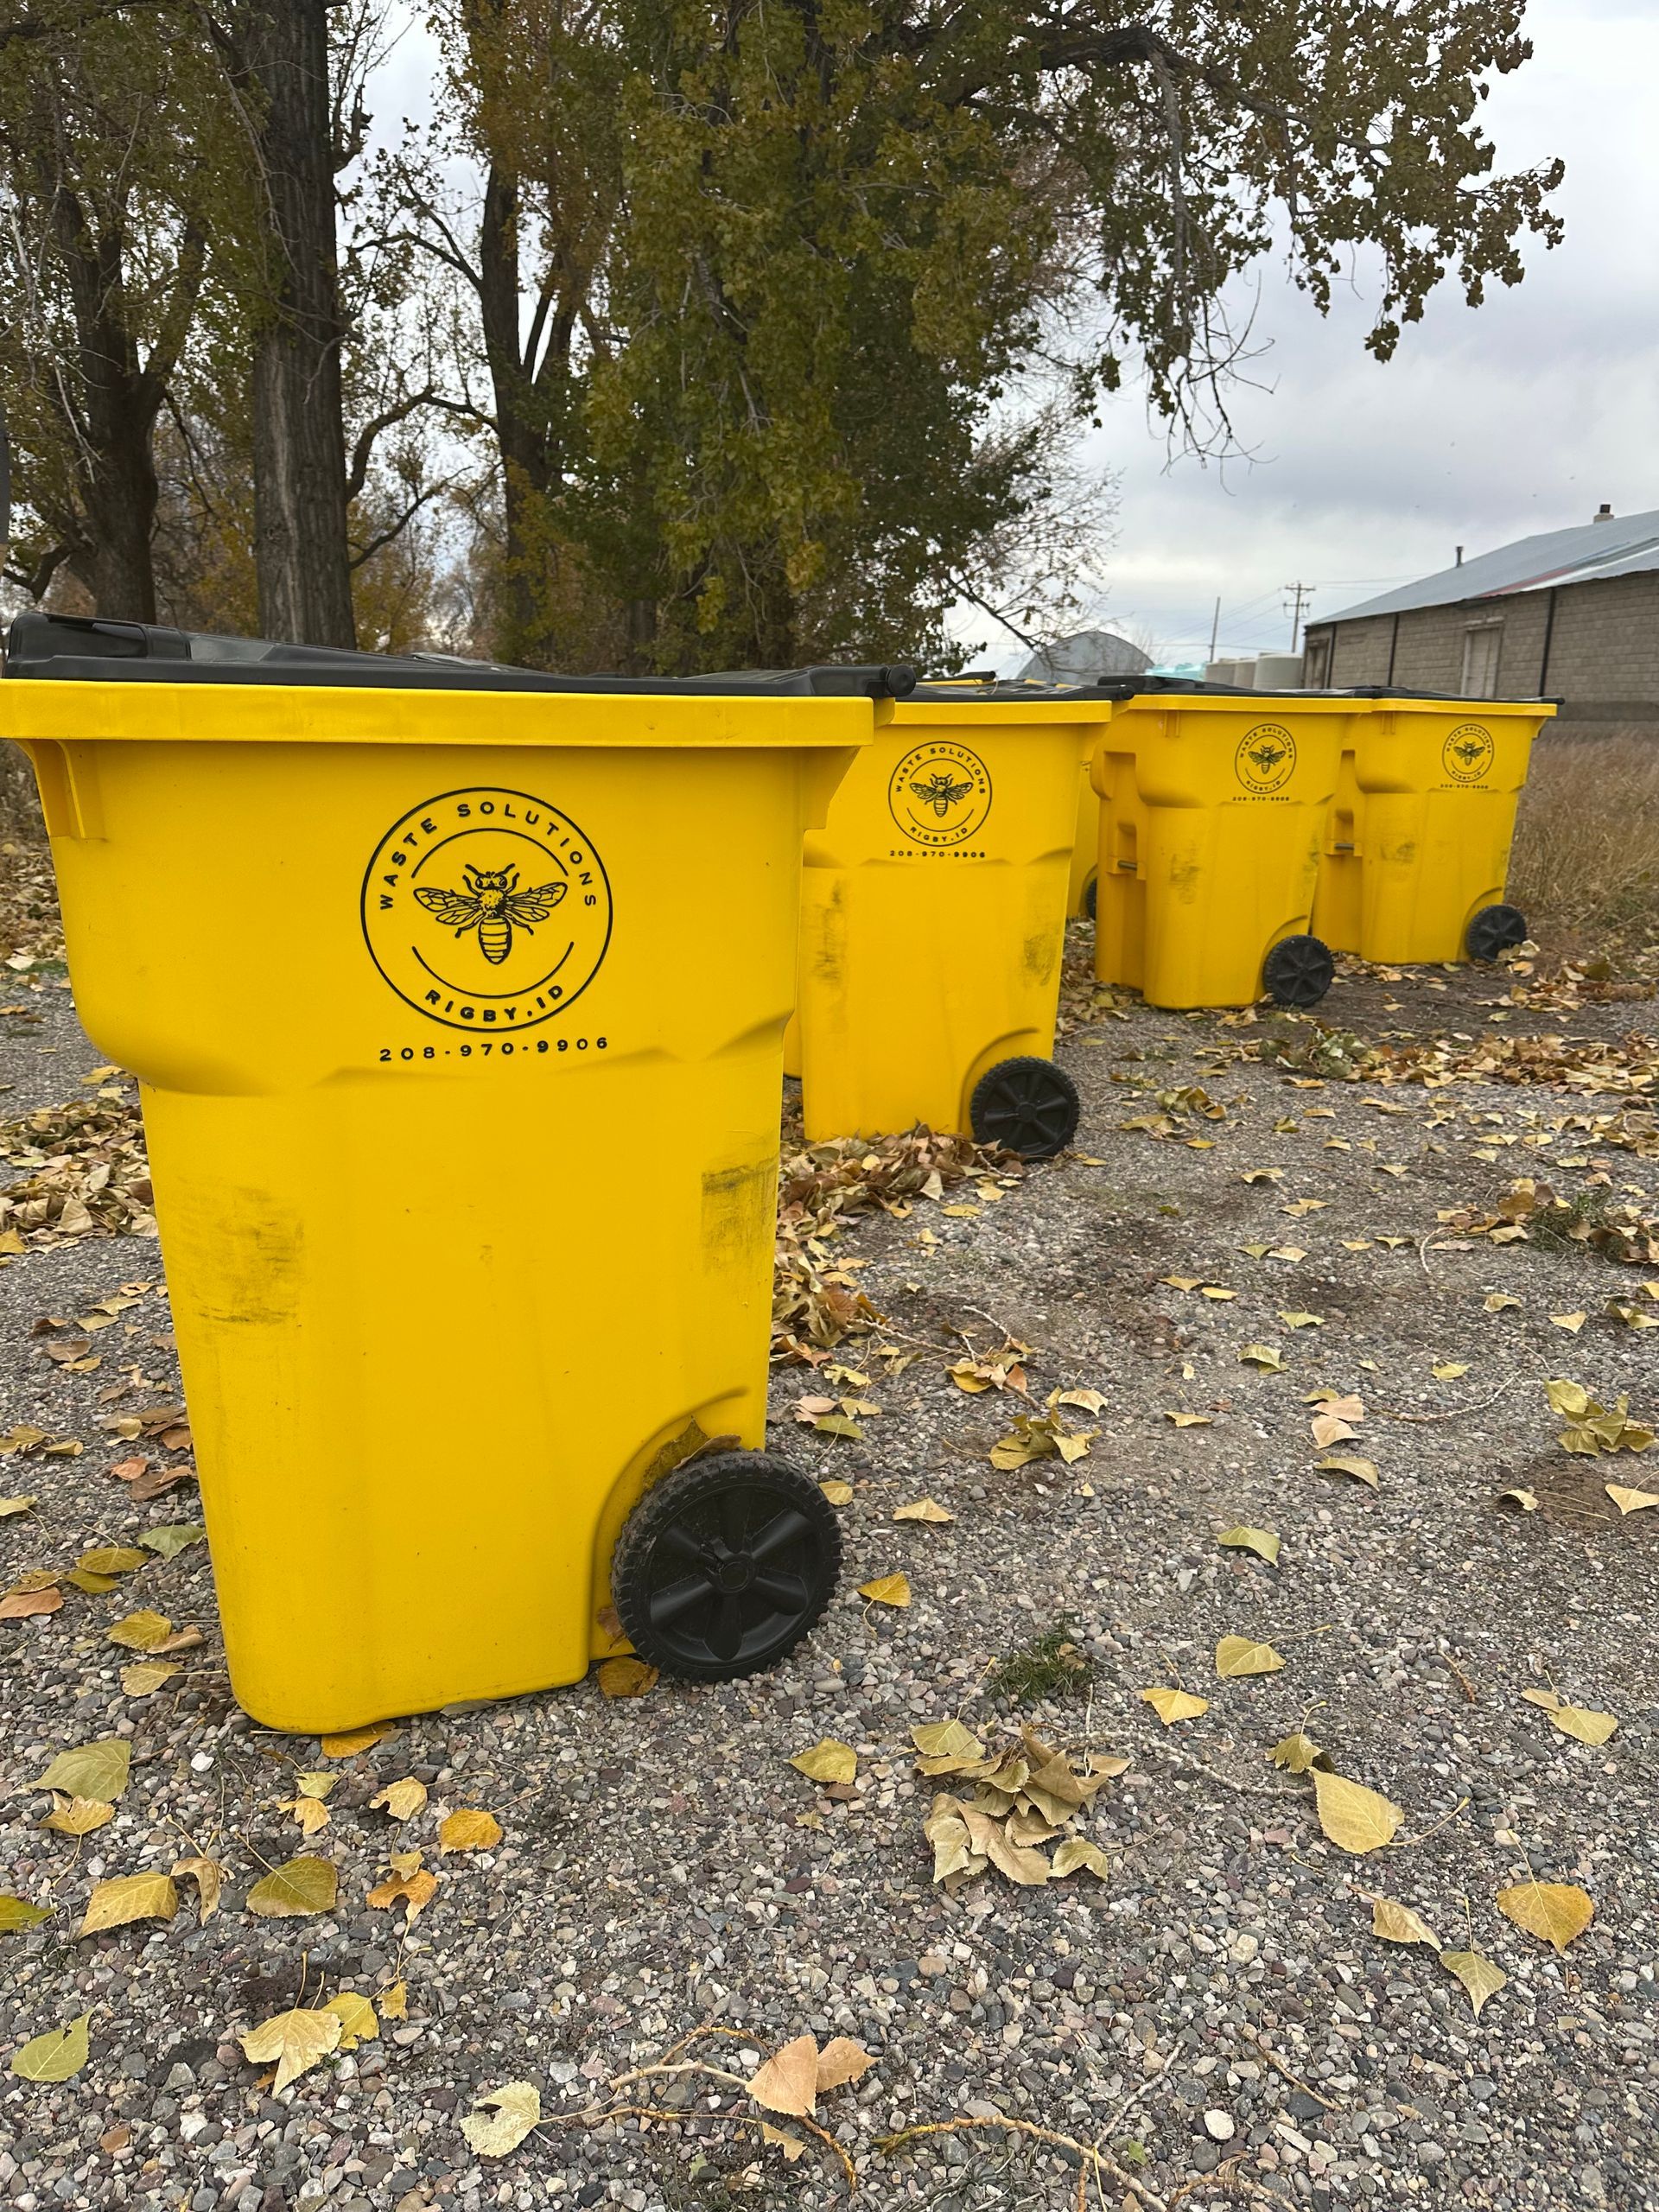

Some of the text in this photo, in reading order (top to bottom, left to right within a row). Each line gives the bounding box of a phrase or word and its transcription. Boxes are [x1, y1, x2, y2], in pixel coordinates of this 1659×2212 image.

[895, 747, 986, 794] WASTE SOLUTIONS
[910, 826, 968, 842] RIGBY.ID
[380, 801, 596, 910] WASTE SOLUTIONS
[425, 985, 563, 1022] RIGBY.ID
[379, 1037, 607, 1062] 208-970-9906
